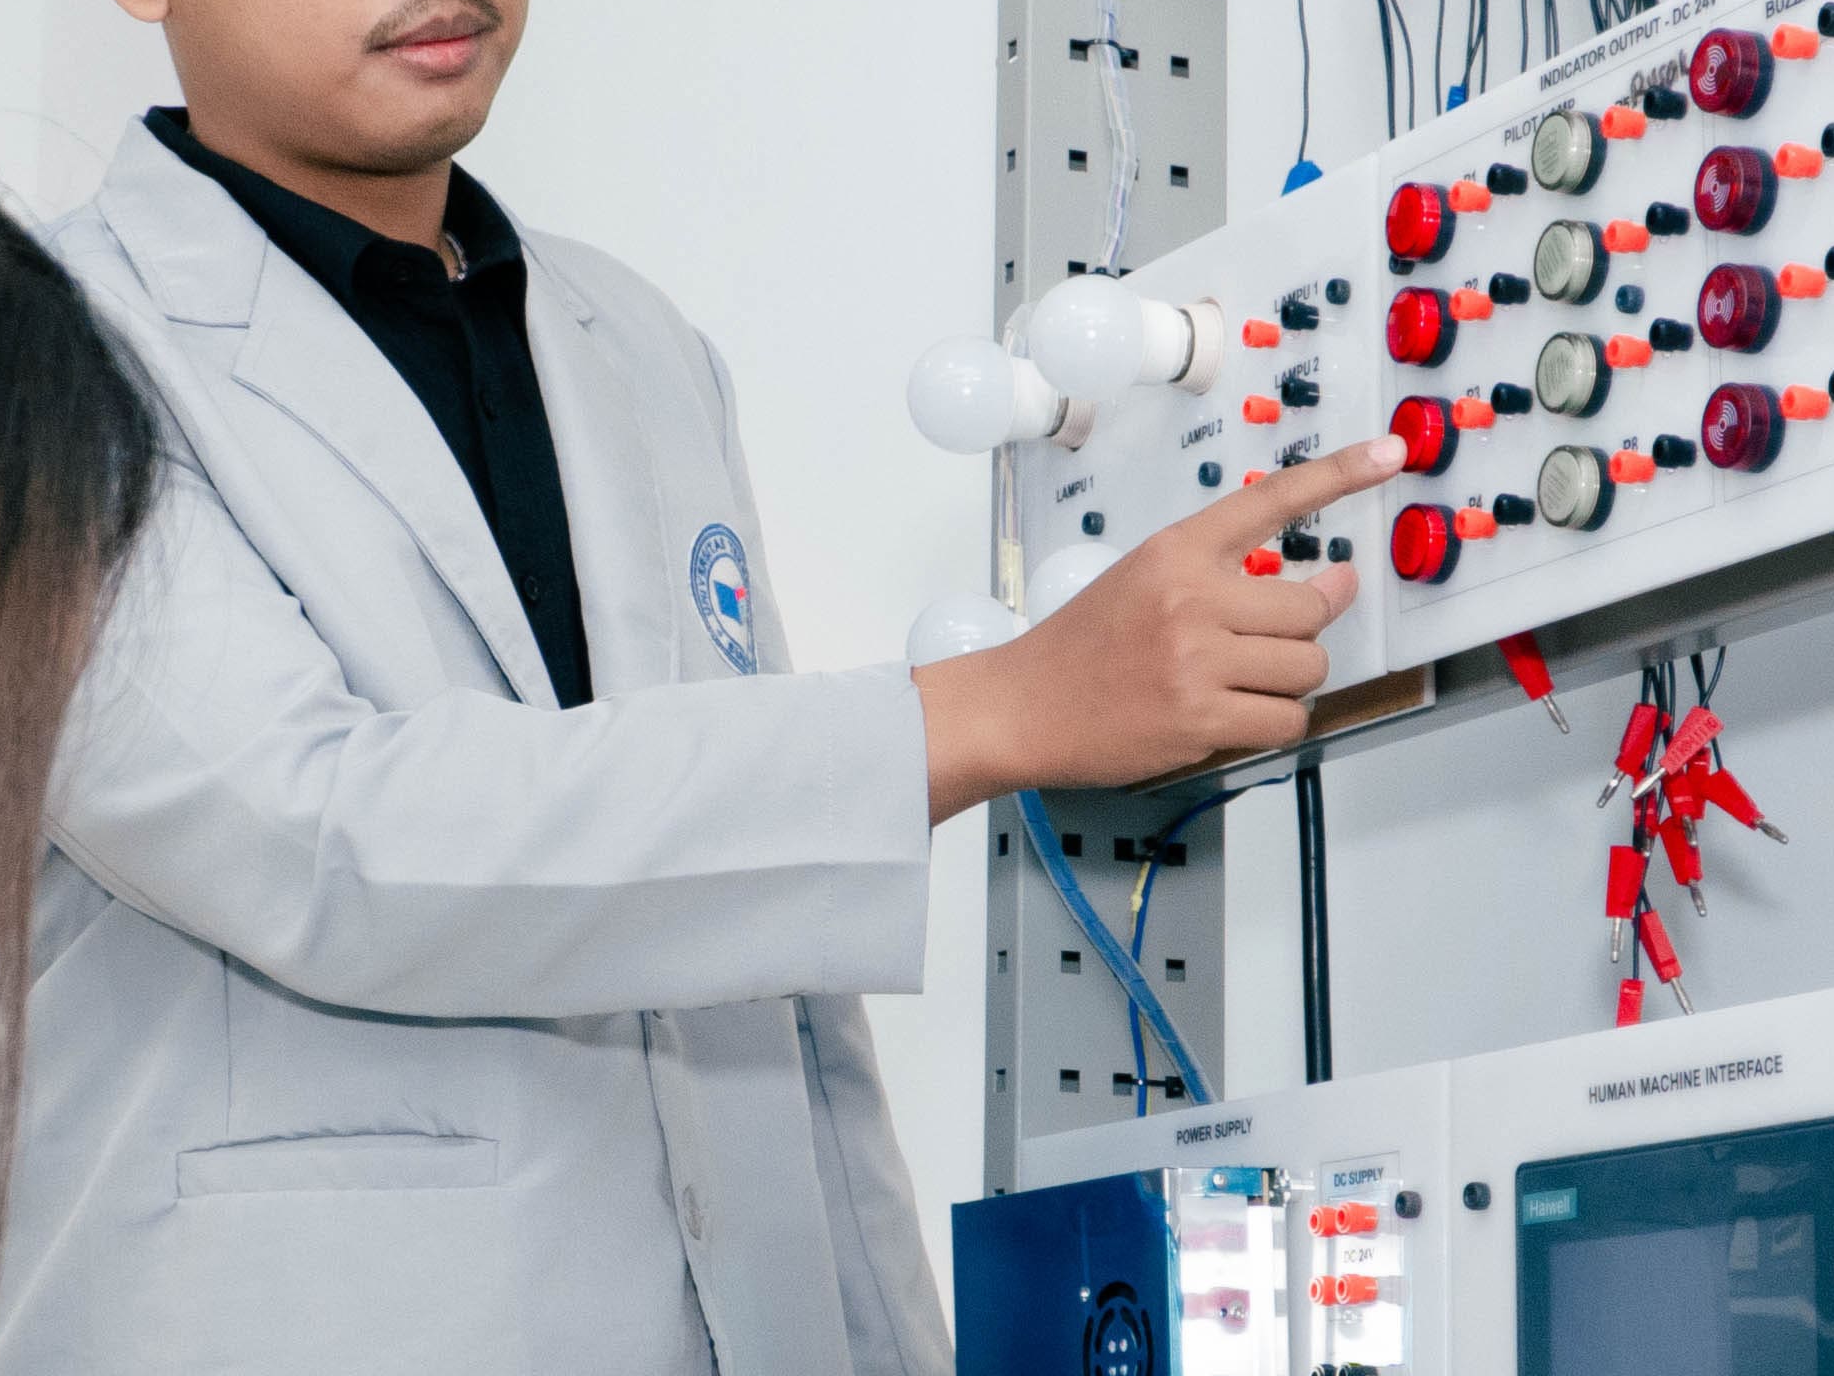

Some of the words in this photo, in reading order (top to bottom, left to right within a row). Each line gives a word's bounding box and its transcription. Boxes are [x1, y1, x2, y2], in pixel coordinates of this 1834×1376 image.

[1540, 45, 1606, 91] INDICATOR
[1610, 18, 1661, 56] OUTPUT
[1674, 6, 1690, 27] DC
[1275, 286, 1310, 313] LAMPU
[1275, 361, 1310, 389] LAMPU
[1313, 357, 1319, 371] 2
[1181, 424, 1215, 448] LAMPU
[1217, 419, 1223, 433] 2
[1275, 439, 1310, 464] LAMPU
[1313, 434, 1320, 448] 3
[1056, 479, 1086, 502] LAMPU
[1589, 1081, 1635, 1104] HUMAN
[1640, 1069, 1701, 1096] MACHINE
[1706, 1056, 1783, 1087] INTERFACE
[1177, 1125, 1212, 1145] POWER
[1215, 1118, 1253, 1139] SUPPLY
[1334, 1172, 1346, 1187] DC
[1349, 1168, 1384, 1184] SUPPLY
[1344, 1250, 1356, 1263] DC
[1359, 1248, 1375, 1262] 24V
